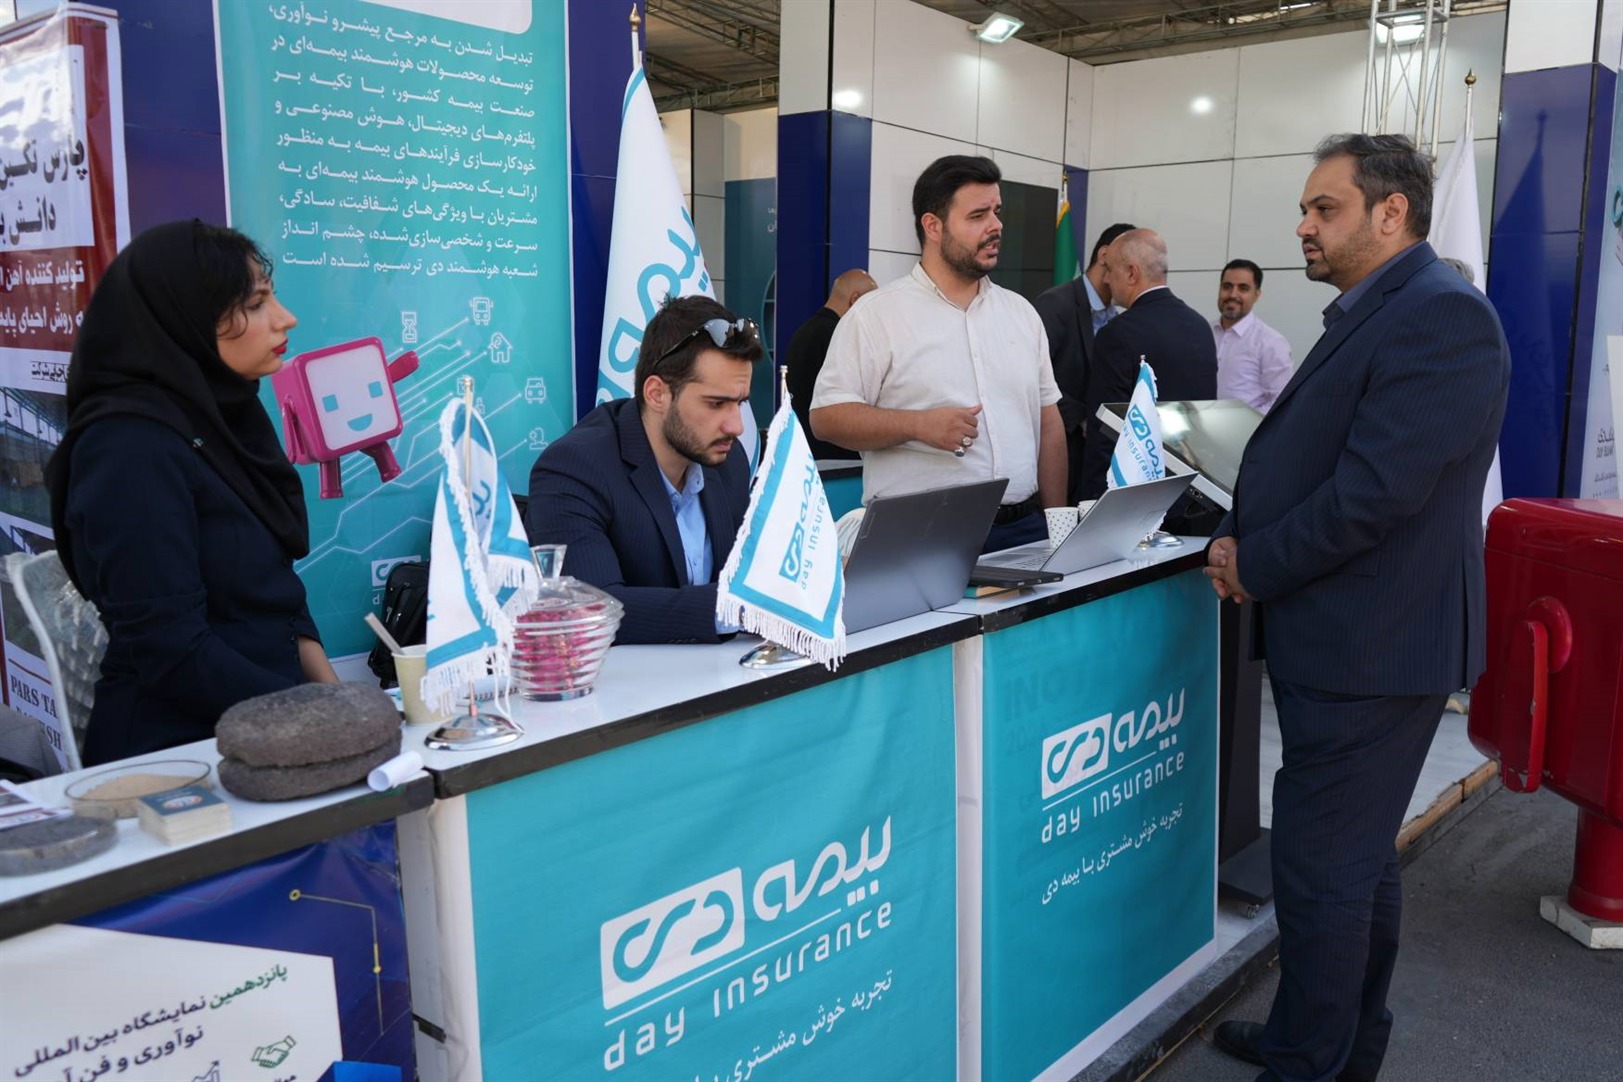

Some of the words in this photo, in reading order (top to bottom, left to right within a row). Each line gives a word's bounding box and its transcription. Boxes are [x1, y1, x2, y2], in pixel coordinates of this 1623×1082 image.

[332, 18, 381, 39] پیشرو
[384, 27, 428, 47] مرجع
[271, 35, 285, 51] در
[430, 35, 452, 52] به
[454, 41, 493, 56] شدن
[351, 48, 414, 74] هوشمند
[495, 45, 533, 67] تبدیل
[273, 70, 301, 85] بر
[309, 72, 352, 90] تکیه
[416, 59, 486, 83] محصولات
[361, 77, 385, 98] با
[488, 75, 534, 95] توسعه
[275, 100, 282, 114] و
[286, 103, 354, 121] مصنوعی
[447, 96, 484, 114] بیمه
[490, 101, 535, 118] صنعت
[357, 107, 405, 129] هوش
[277, 128, 324, 147] منظور
[327, 136, 351, 153] به
[354, 140, 390, 158] بیمه
[393, 142, 460, 166] فرآیندهای
[278, 160, 302, 178] به
[361, 169, 419, 190] هوشمند
[422, 173, 475, 193] محصول
[477, 179, 504, 198] یک
[507, 184, 538, 203] ارائه
[9, 195, 56, 246] دانش
[469, 206, 484, 224] با
[487, 208, 538, 227] مشتریان
[281, 219, 319, 239] انداز
[322, 225, 365, 244] چشم
[486, 240, 493, 252] و
[494, 238, 539, 254] سرعت
[282, 252, 326, 266] است
[330, 253, 370, 268] شده
[373, 259, 422, 275] ترسیم
[426, 262, 444, 276] دی
[6, 260, 23, 292] آهن
[25, 261, 54, 286] کننده
[55, 260, 85, 291] تولید
[446, 260, 500, 279] هوشمند
[502, 263, 538, 279] شعبه
[19, 306, 47, 334] احیای
[50, 302, 73, 335] روش
[10, 675, 39, 708] PARS
[1113, 687, 1185, 753] بیمه
[1041, 805, 1080, 844] day
[1160, 803, 1184, 830] تجربه
[1134, 817, 1157, 849] خوش
[1096, 834, 1133, 872] مشتری
[752, 815, 891, 921] بیمه
[1082, 857, 1094, 875] با
[1061, 868, 1080, 887] بیمه
[1041, 881, 1059, 905] دی
[209, 964, 288, 1010] پانزدهمین
[851, 969, 893, 1012] تجربه
[122, 997, 206, 1035] نمایشگاه
[803, 998, 846, 1046] خوش
[83, 1029, 119, 1052] بین
[133, 1025, 205, 1066] نوآوری
[604, 1006, 685, 1071] day
[14, 1036, 80, 1078] المللی
[117, 1058, 129, 1073] و
[727, 1030, 797, 1082] مشتری
